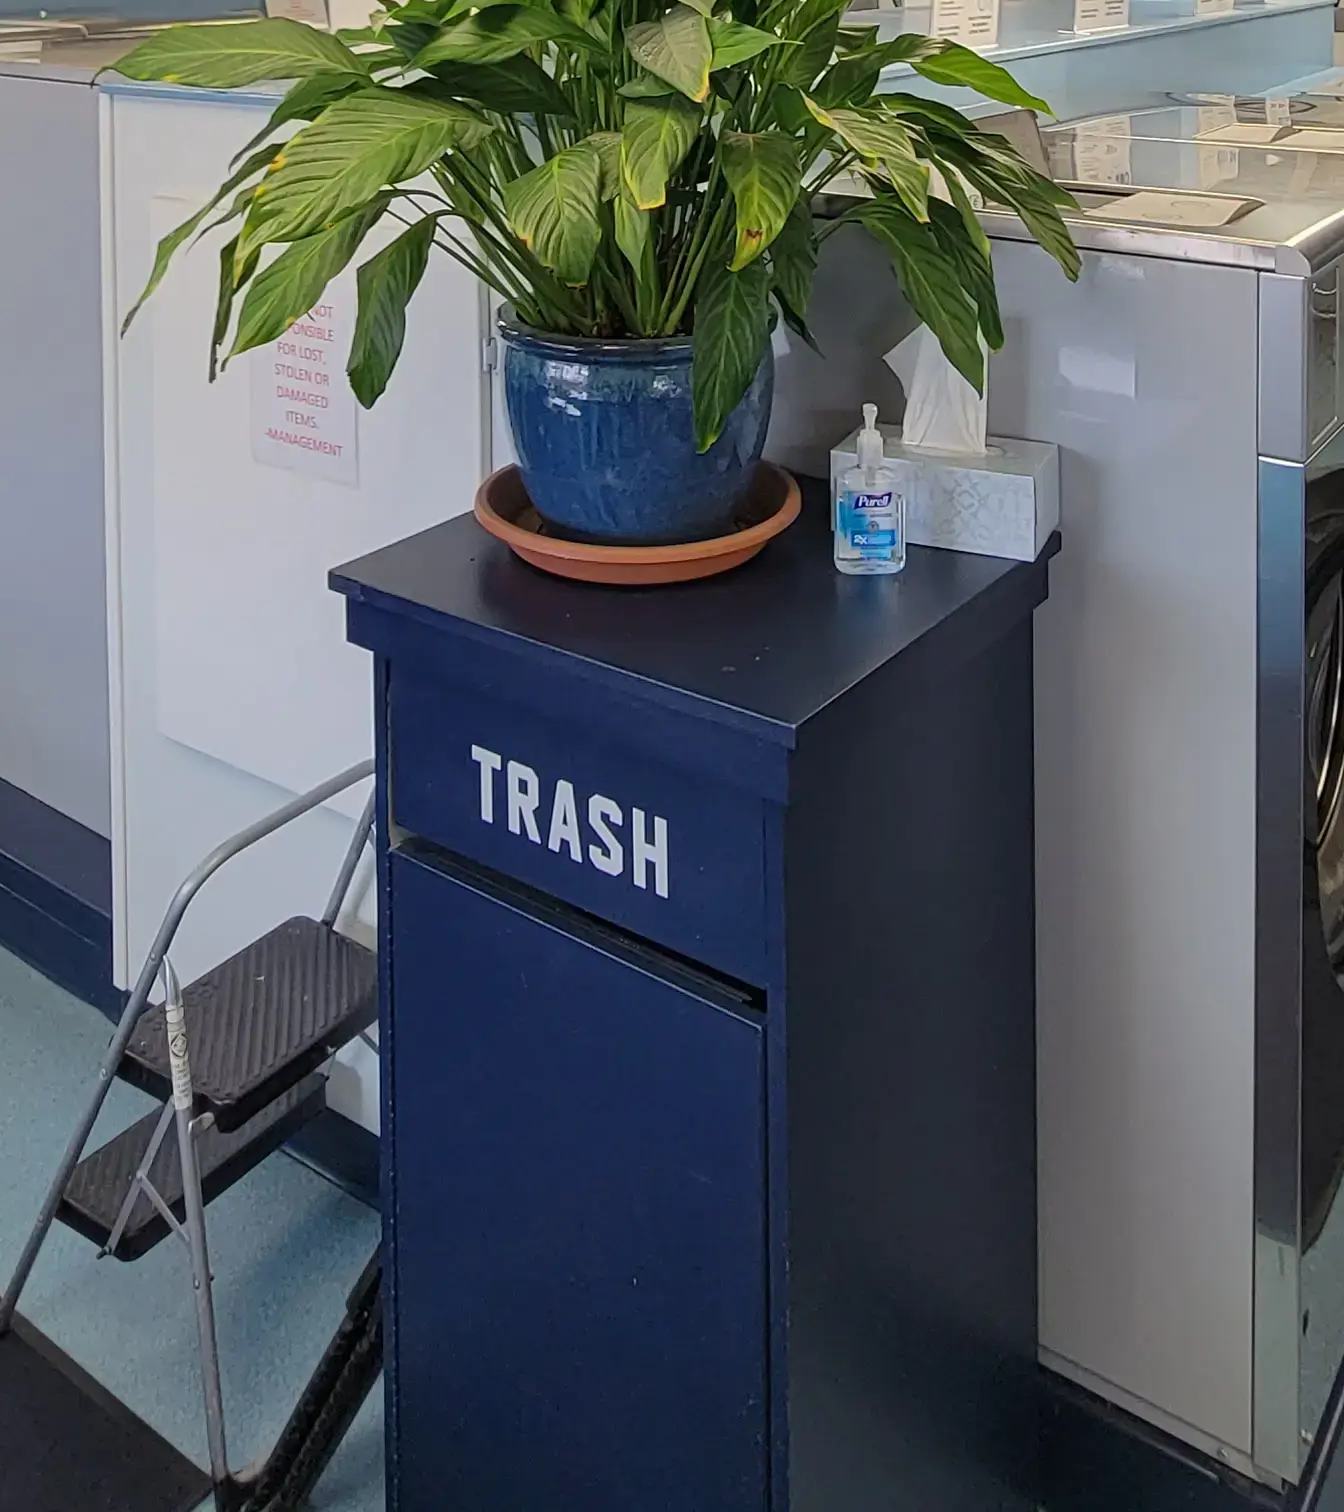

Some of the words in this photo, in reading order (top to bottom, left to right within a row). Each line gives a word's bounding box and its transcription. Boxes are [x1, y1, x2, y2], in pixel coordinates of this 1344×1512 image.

[276, 340, 297, 356] FOR
[274, 363, 312, 382] STOLEN
[315, 372, 330, 387] OR
[276, 385, 329, 409] DAMAGED
[471, 744, 669, 900] TRASH
